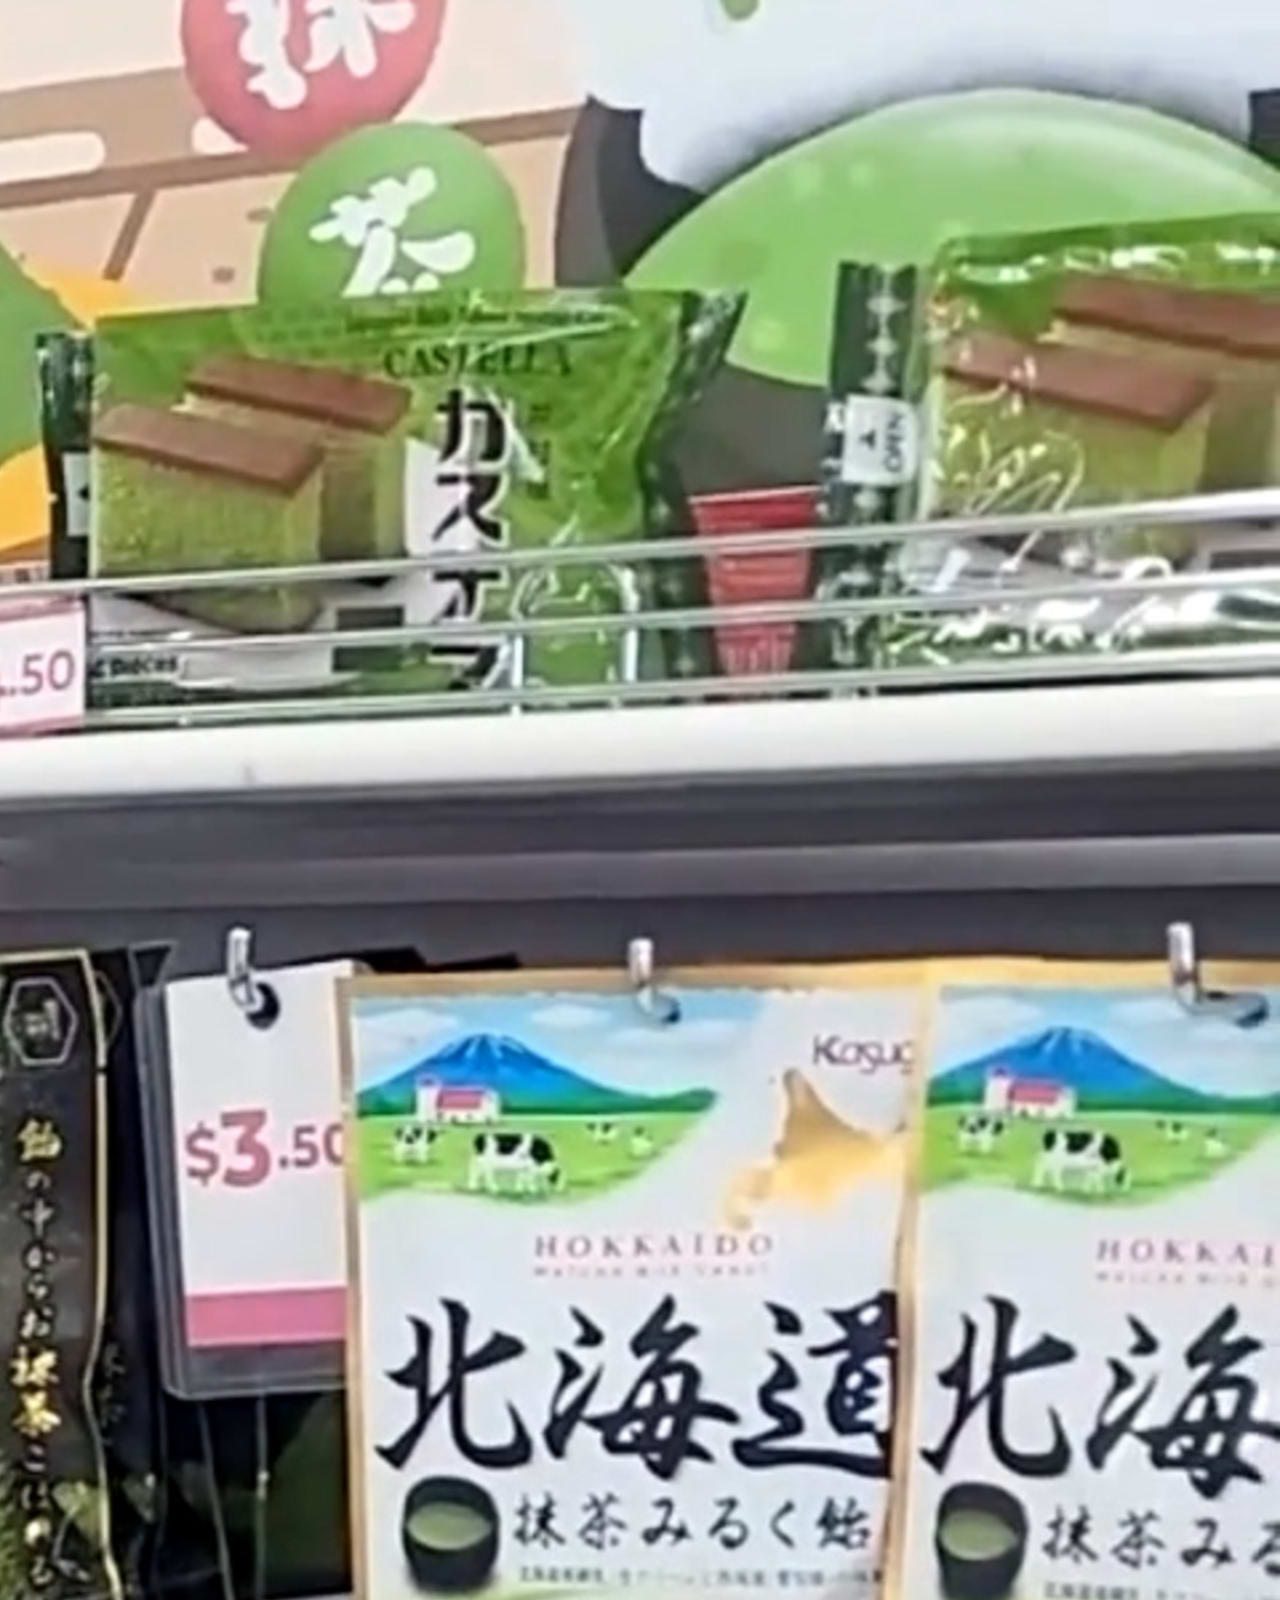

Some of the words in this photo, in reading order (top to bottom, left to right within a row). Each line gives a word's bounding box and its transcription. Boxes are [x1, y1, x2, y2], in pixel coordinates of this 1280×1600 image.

[186, 1109, 345, 1188] $3.50
[533, 1235, 772, 1258] HOKKAIDO
[375, 1291, 899, 1481] 北海道
[514, 1491, 870, 1550] 抹茶みるく飴
